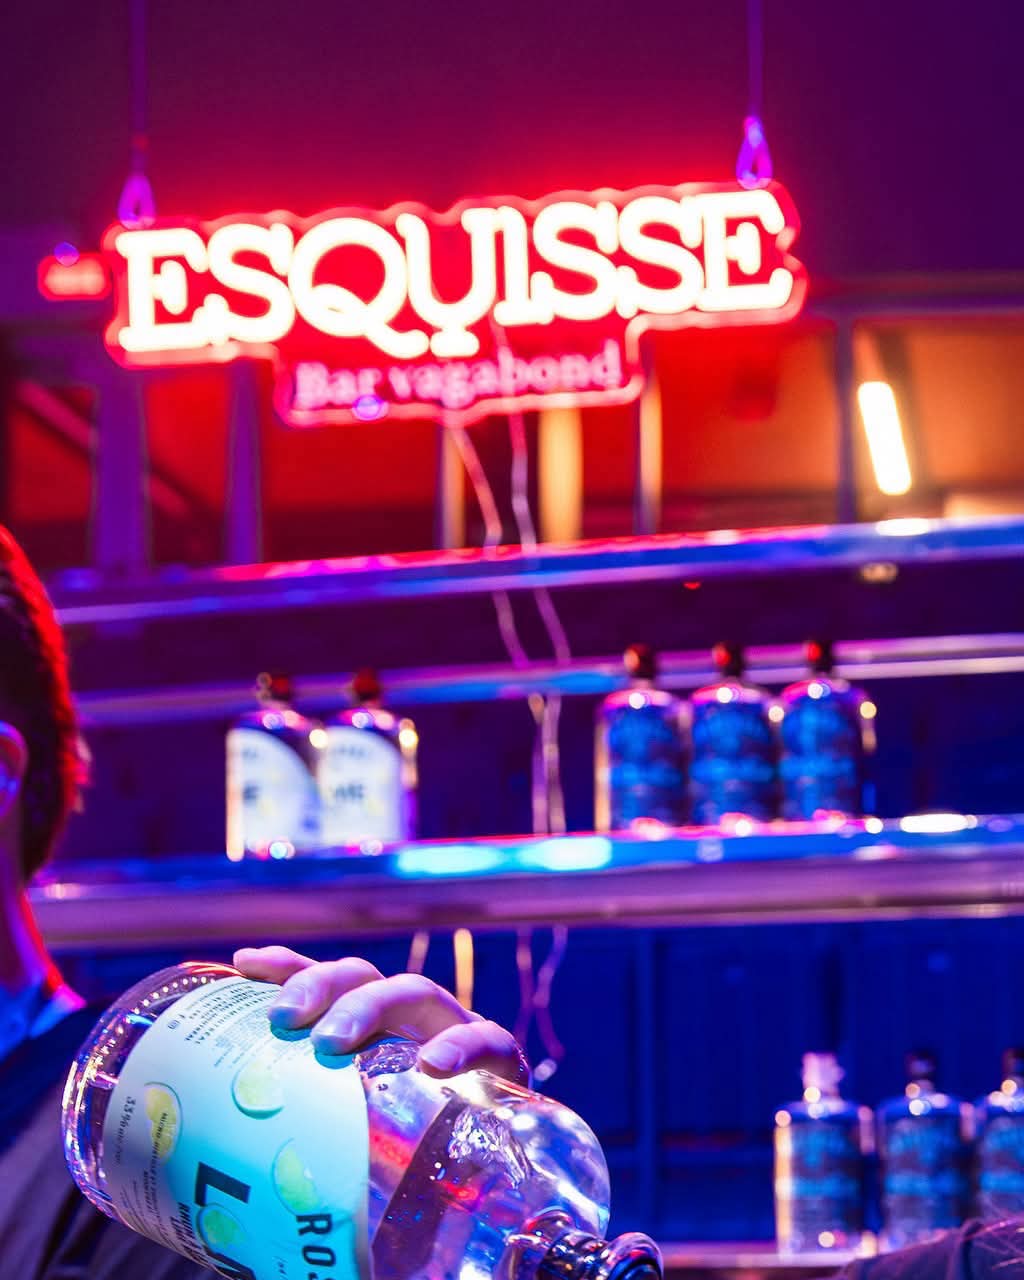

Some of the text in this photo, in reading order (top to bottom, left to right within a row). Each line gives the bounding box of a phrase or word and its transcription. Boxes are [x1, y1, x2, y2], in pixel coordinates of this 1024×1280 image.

[116, 188, 795, 359] ESQUISSE
[296, 339, 622, 409] Bar vagabond
